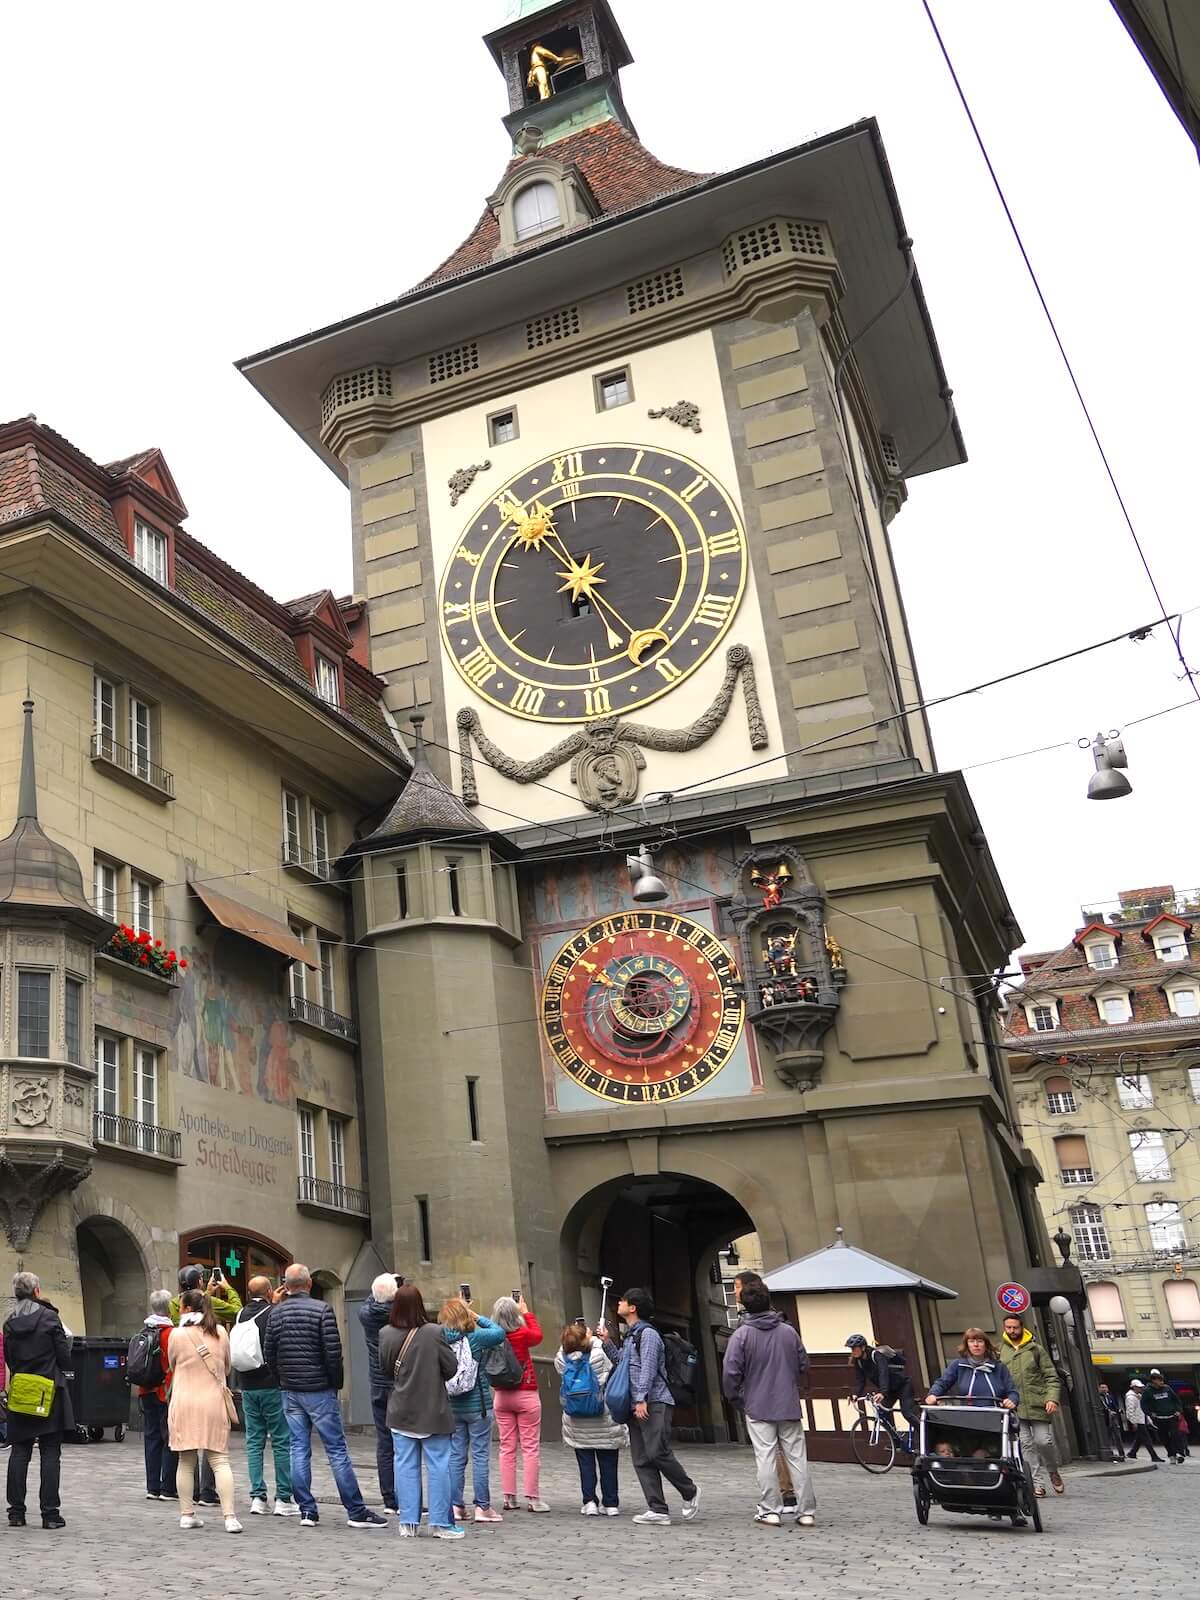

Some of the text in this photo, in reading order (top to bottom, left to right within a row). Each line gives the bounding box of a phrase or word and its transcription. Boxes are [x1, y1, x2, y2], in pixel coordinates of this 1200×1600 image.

[551, 452, 584, 484] XII
[179, 1105, 293, 1159] Apotheke und Drogerie
[196, 1138, 278, 1187] Scheidegger
